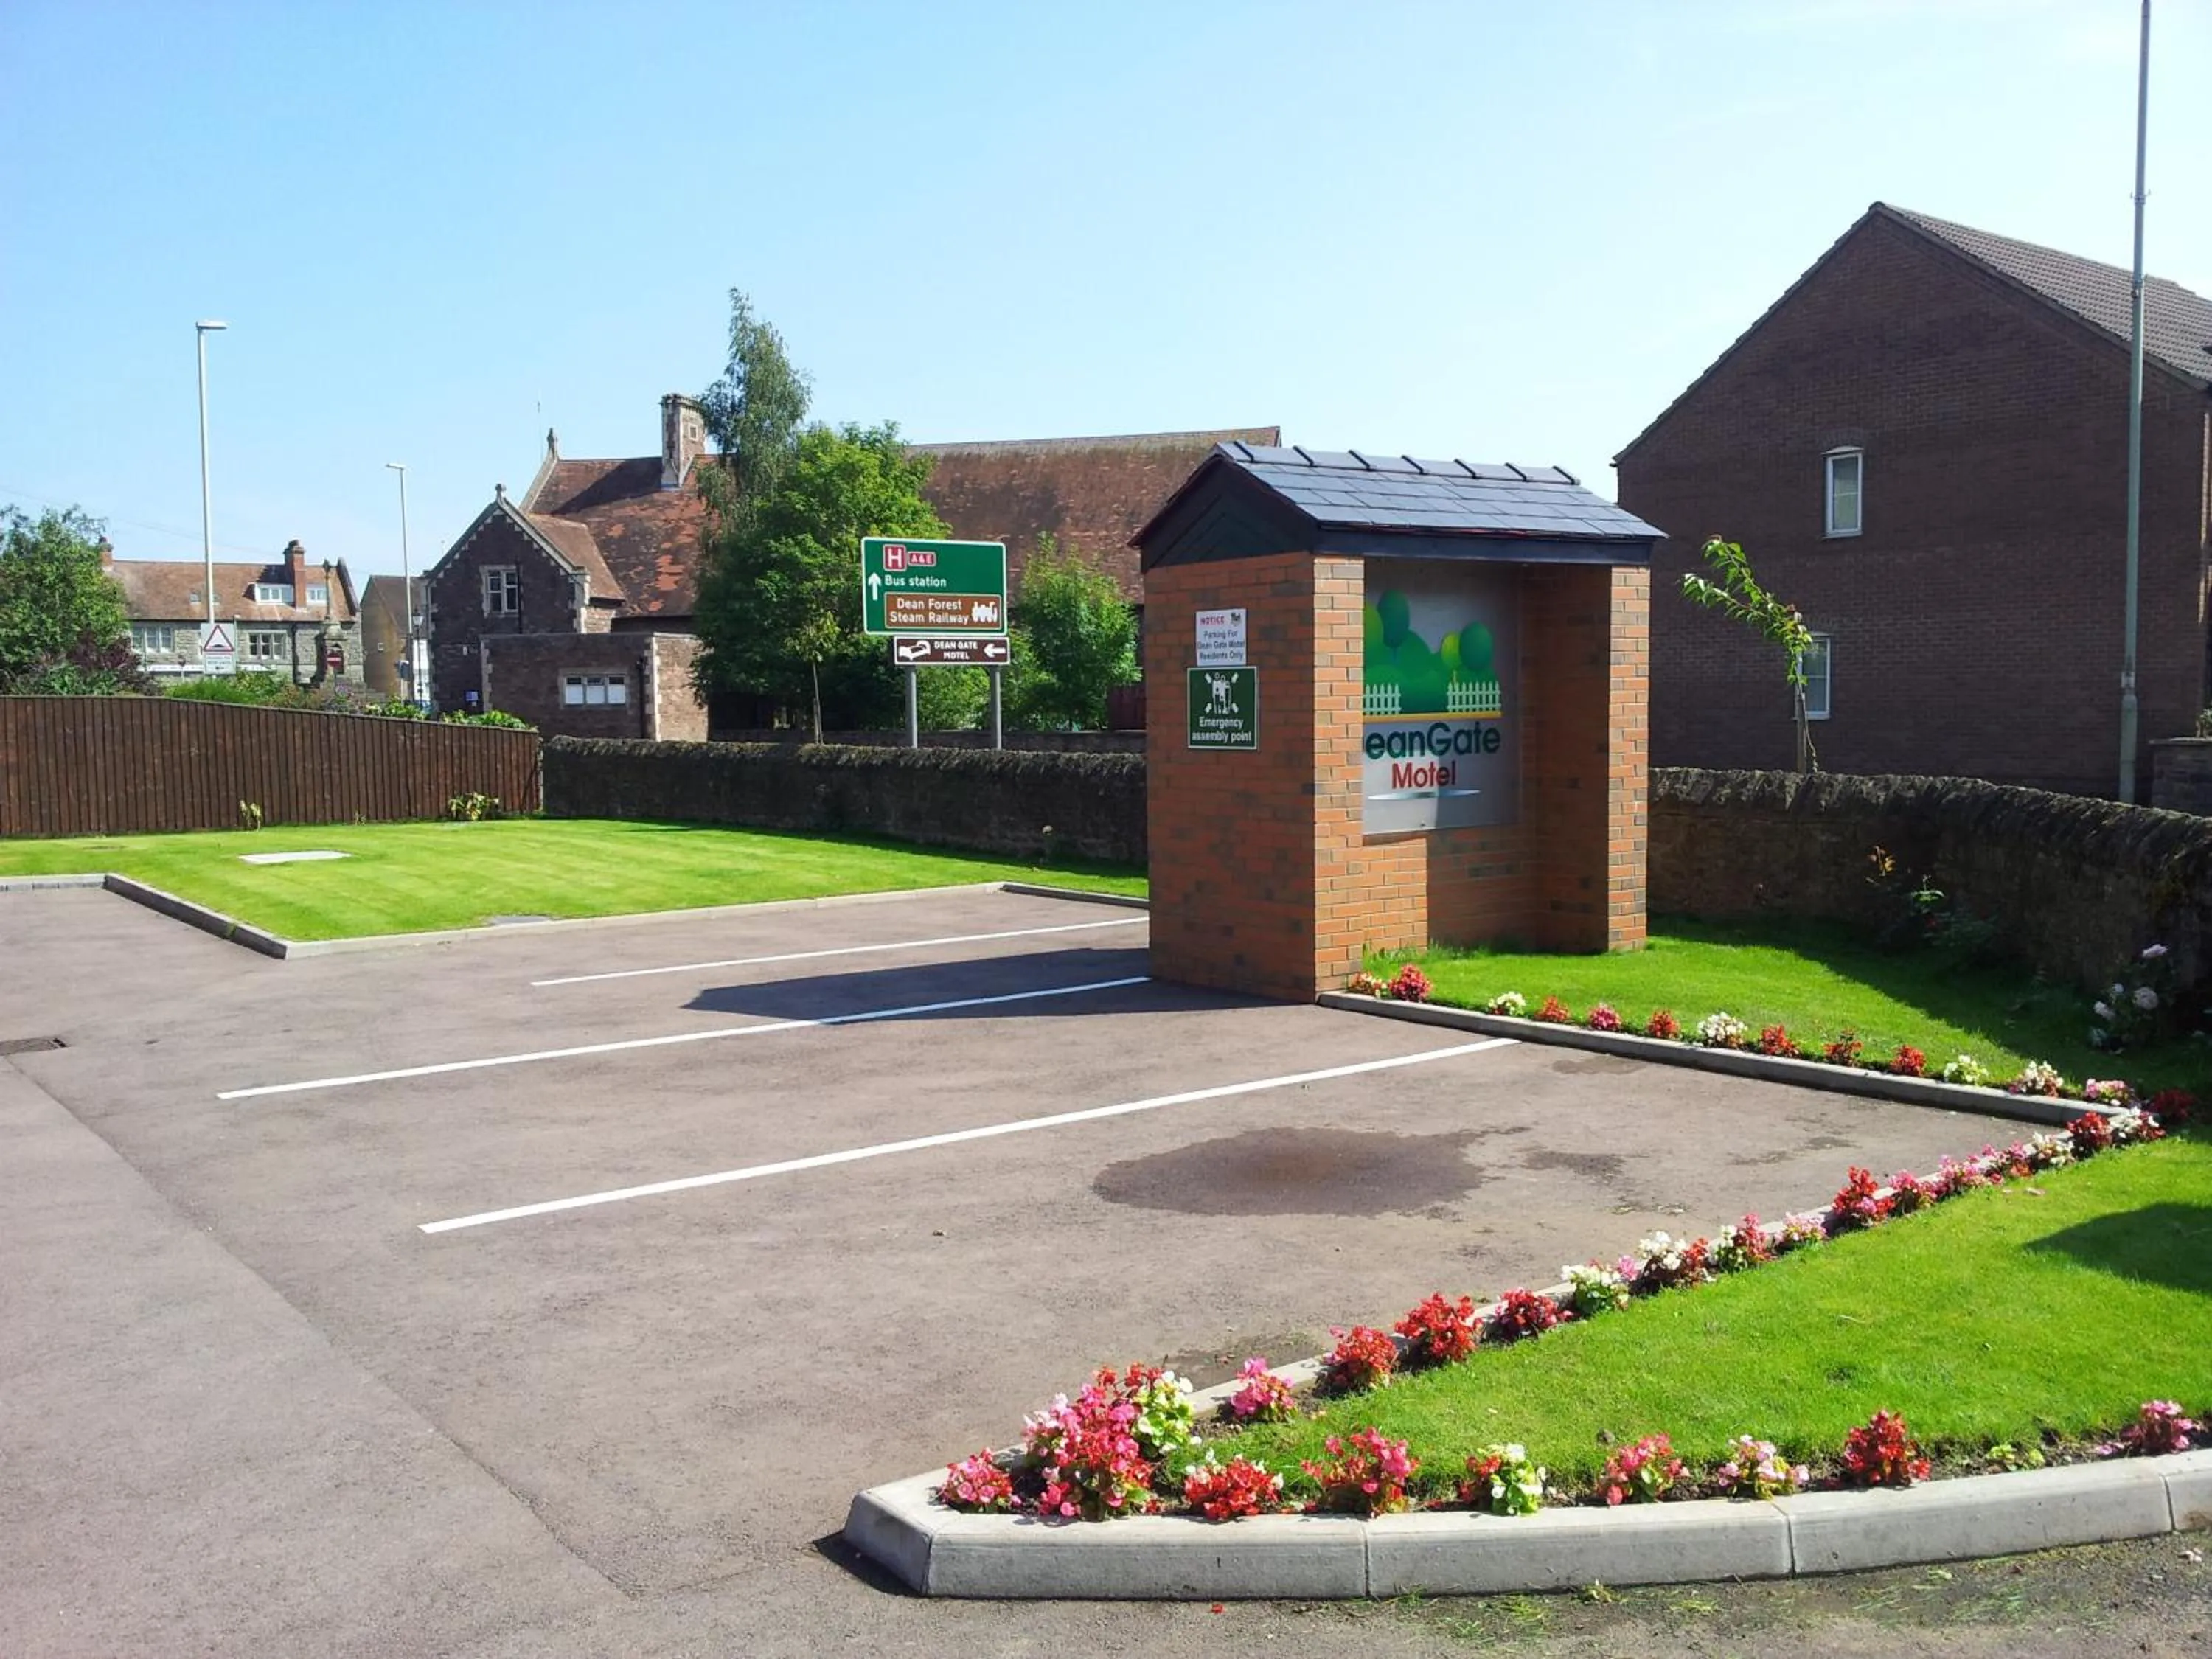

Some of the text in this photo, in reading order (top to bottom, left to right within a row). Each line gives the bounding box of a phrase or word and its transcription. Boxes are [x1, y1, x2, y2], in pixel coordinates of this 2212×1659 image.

[888, 548, 902, 568] H
[885, 574, 947, 588] Bus station
[897, 598, 962, 611] Dean Forest
[890, 611, 969, 625] Steam Railway
[1200, 616, 1225, 625] NOTICE
[934, 641, 978, 650] DEAN GATE
[943, 651, 970, 660] MOTEL
[1198, 716, 1244, 730] Emergency
[1192, 731, 1251, 744] assembly point
[1362, 722, 1500, 760] eanGate
[1391, 760, 1456, 789] Motel
